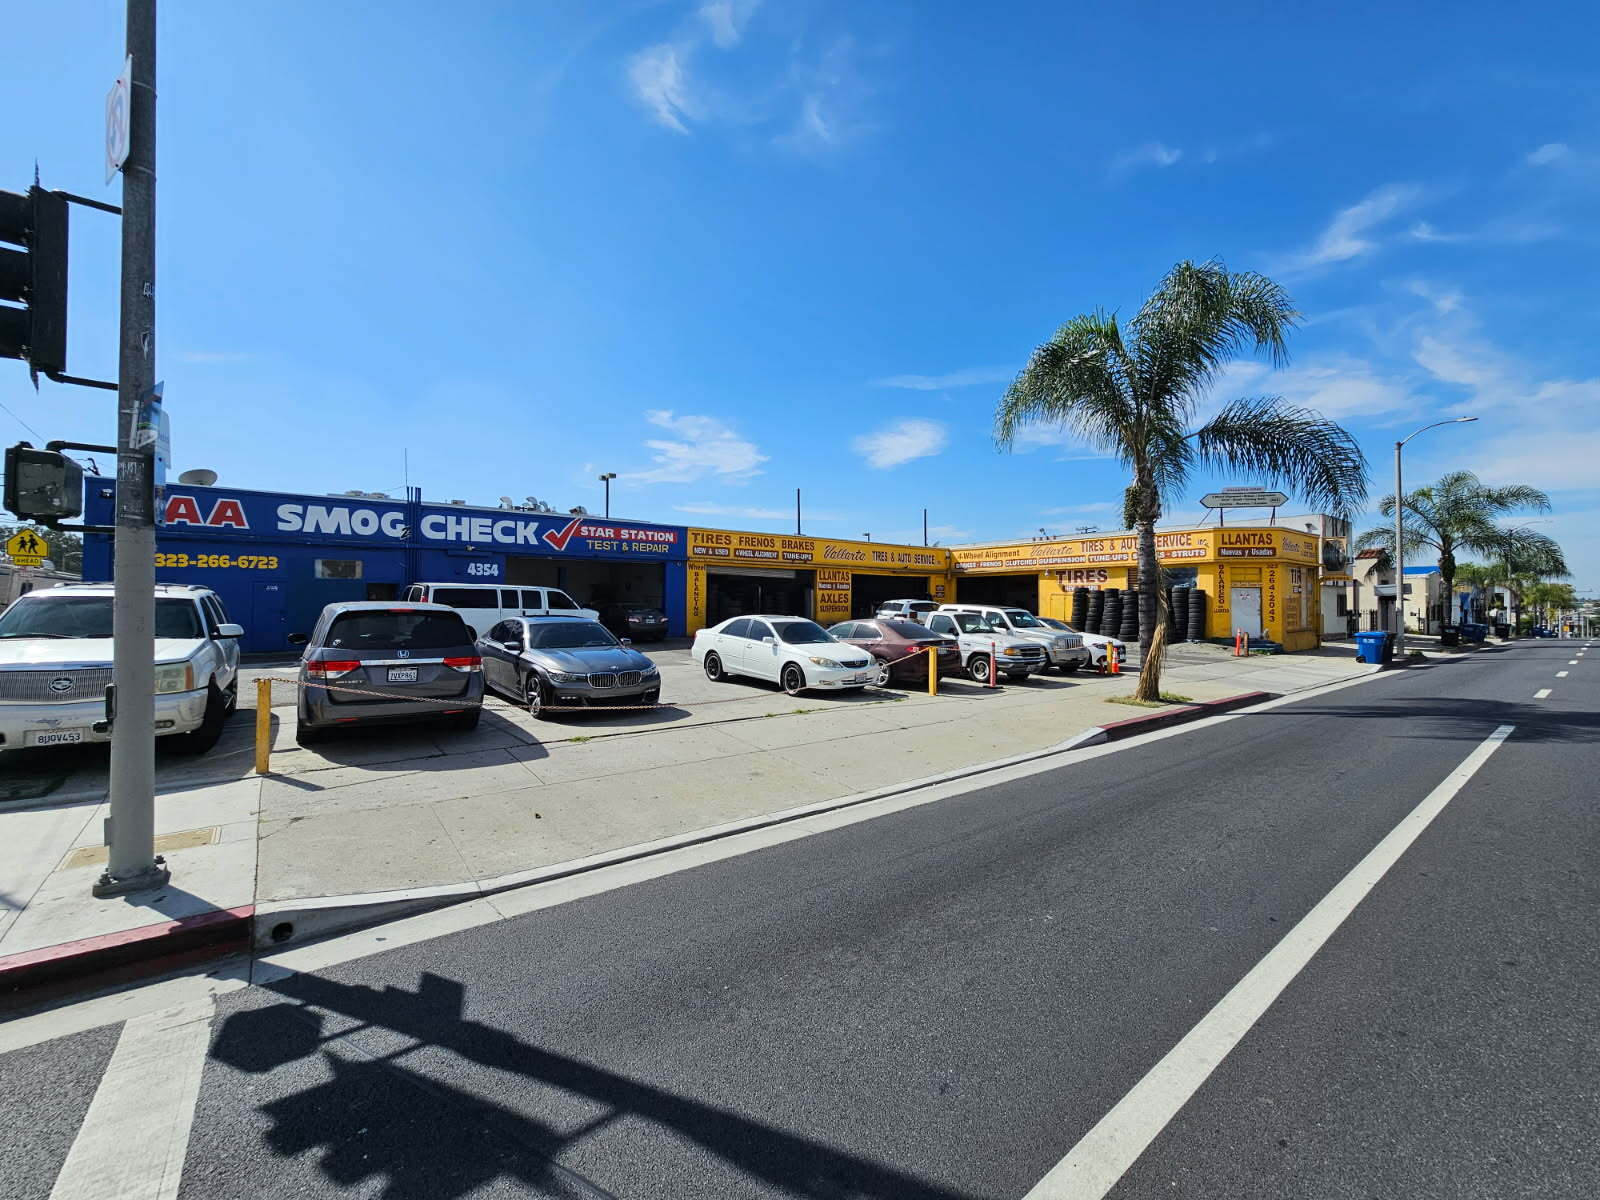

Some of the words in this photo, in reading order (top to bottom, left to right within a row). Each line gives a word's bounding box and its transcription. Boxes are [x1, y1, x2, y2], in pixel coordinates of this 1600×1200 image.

[277, 504, 406, 538] SMOG
[420, 514, 540, 545] CHECK
[580, 526, 615, 538] STAR
[620, 529, 674, 542] STATION
[1221, 533, 1273, 546] LLANTAS
[586, 539, 619, 551] TEST
[622, 542, 629, 551] &
[632, 542, 670, 553] REPAIR
[691, 532, 732, 546] TIRES
[738, 536, 775, 548] FRENOS
[781, 539, 815, 551] BRAKES
[1080, 540, 1105, 553] TIRES
[1109, 541, 1115, 551] &
[1120, 537, 1139, 550] AUT
[1155, 534, 1192, 547] ERVICE
[872, 551, 888, 562] TIRES
[890, 551, 895, 562] &
[898, 553, 912, 563] AUTO
[914, 554, 935, 565] SERVICE
[963, 552, 984, 560] Wheel
[985, 549, 1020, 560] Alignment
[1171, 549, 1206, 558] STRUTS
[1220, 548, 1242, 556] Nuevas
[1245, 549, 1249, 557] y
[1251, 548, 1273, 556] Usadas
[154, 553, 278, 569] 323-266-6723
[467, 562, 499, 577] 4354
[818, 568, 850, 581] LLANTAS
[1055, 569, 1108, 584] TIRES
[820, 592, 849, 604] AXLES
